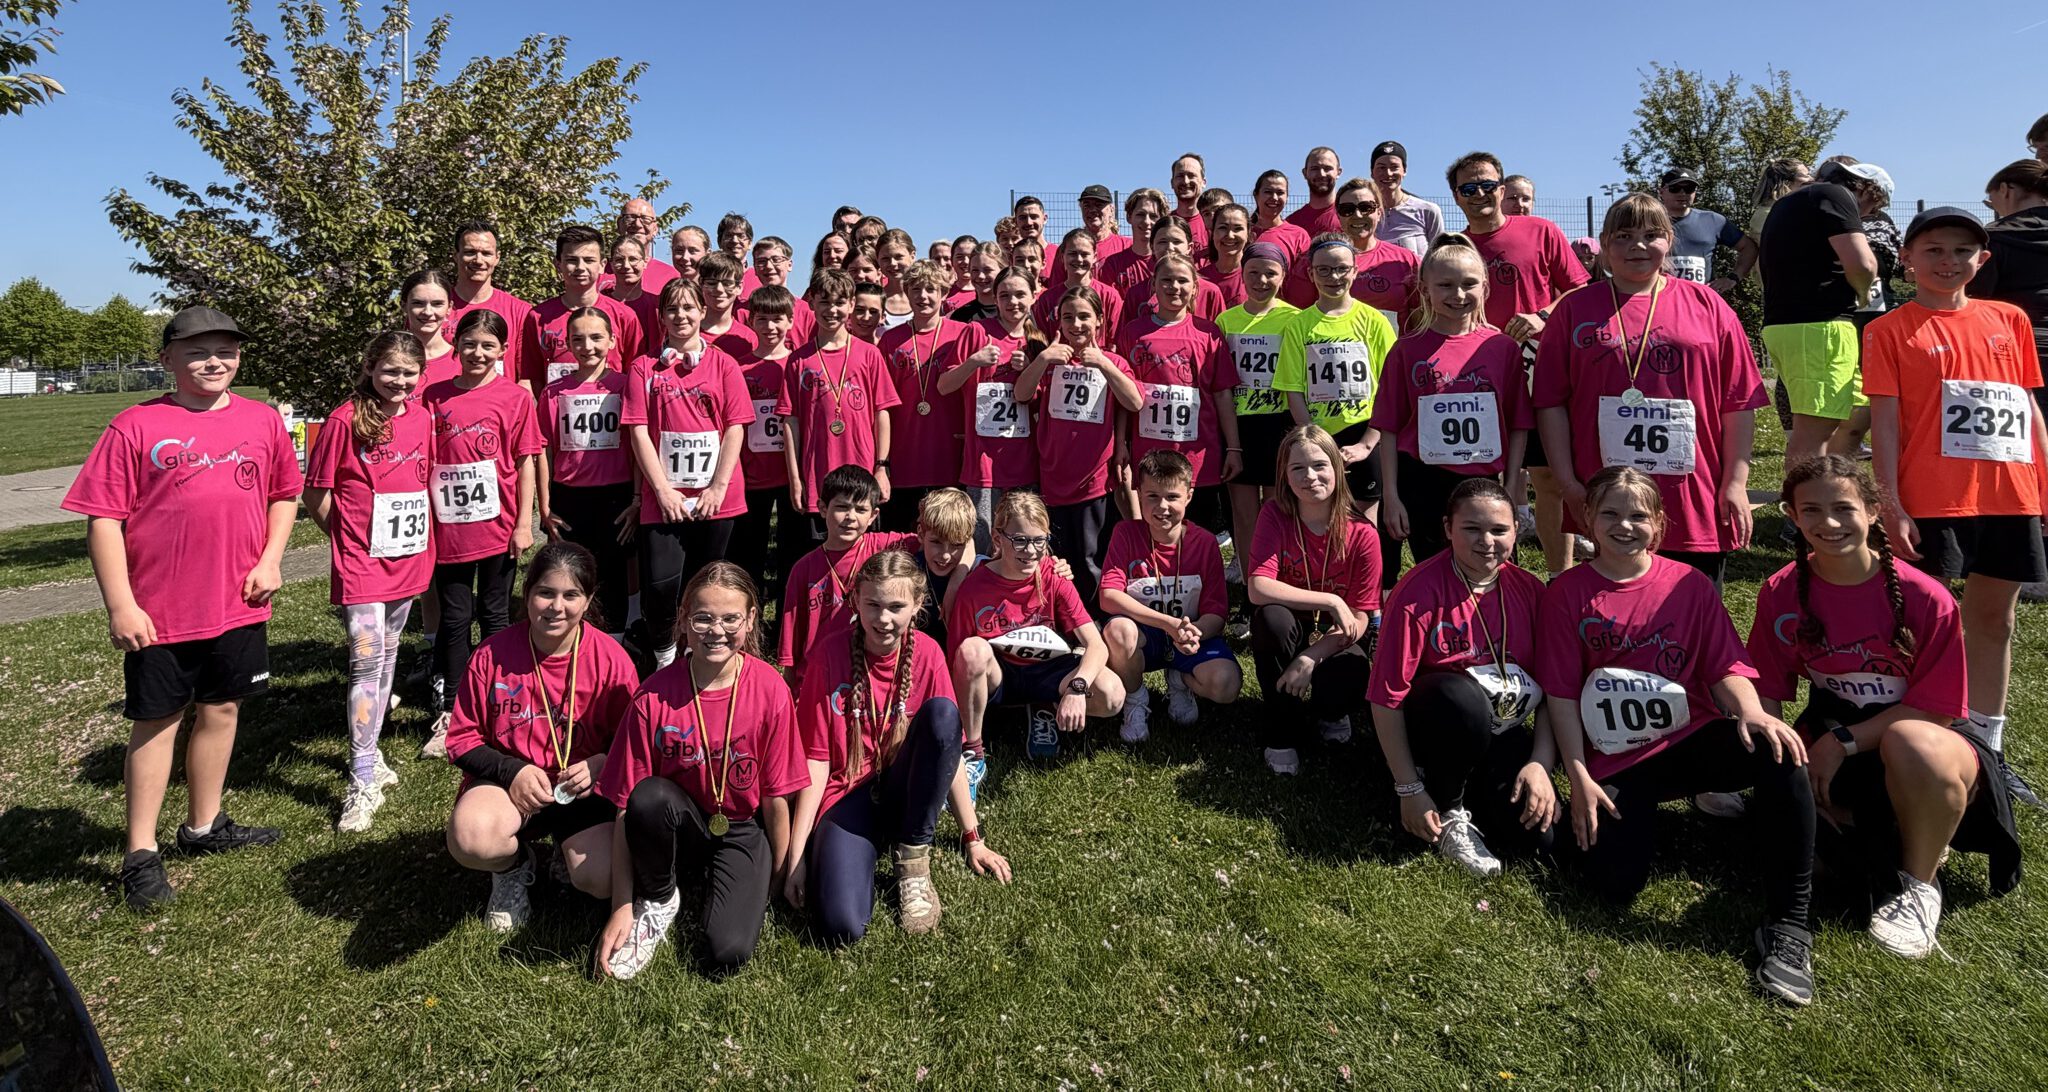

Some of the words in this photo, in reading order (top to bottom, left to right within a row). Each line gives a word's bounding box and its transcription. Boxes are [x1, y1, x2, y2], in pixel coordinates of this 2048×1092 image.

[1240, 337, 1268, 346] enni.
[1320, 345, 1349, 355] enni.
[1062, 370, 1096, 382] enni.
[1308, 361, 1367, 385] 1419
[1063, 384, 1090, 406] 79
[1152, 390, 1189, 401] enni.
[1970, 387, 2016, 402] enni.
[992, 402, 1018, 422] 24
[1434, 397, 1484, 413] enni.
[1617, 403, 1677, 420] enni.
[562, 412, 618, 434] 1400
[1149, 403, 1191, 426] 119
[1946, 405, 2025, 440] 2321
[1442, 417, 1480, 445] 90
[1624, 424, 1669, 453] 46
[672, 436, 711, 448] enni.
[164, 450, 199, 470] gfb
[669, 452, 712, 473] 117
[440, 466, 482, 481] enni.
[391, 494, 426, 511] enni.
[440, 482, 487, 507] 154
[387, 512, 426, 539] 133
[984, 616, 1009, 633] gfb
[1006, 629, 1053, 643] enni.
[1595, 674, 1662, 692] enni.
[1826, 677, 1894, 696] enni.
[1597, 698, 1673, 731] 109
[663, 742, 694, 758] gfb
